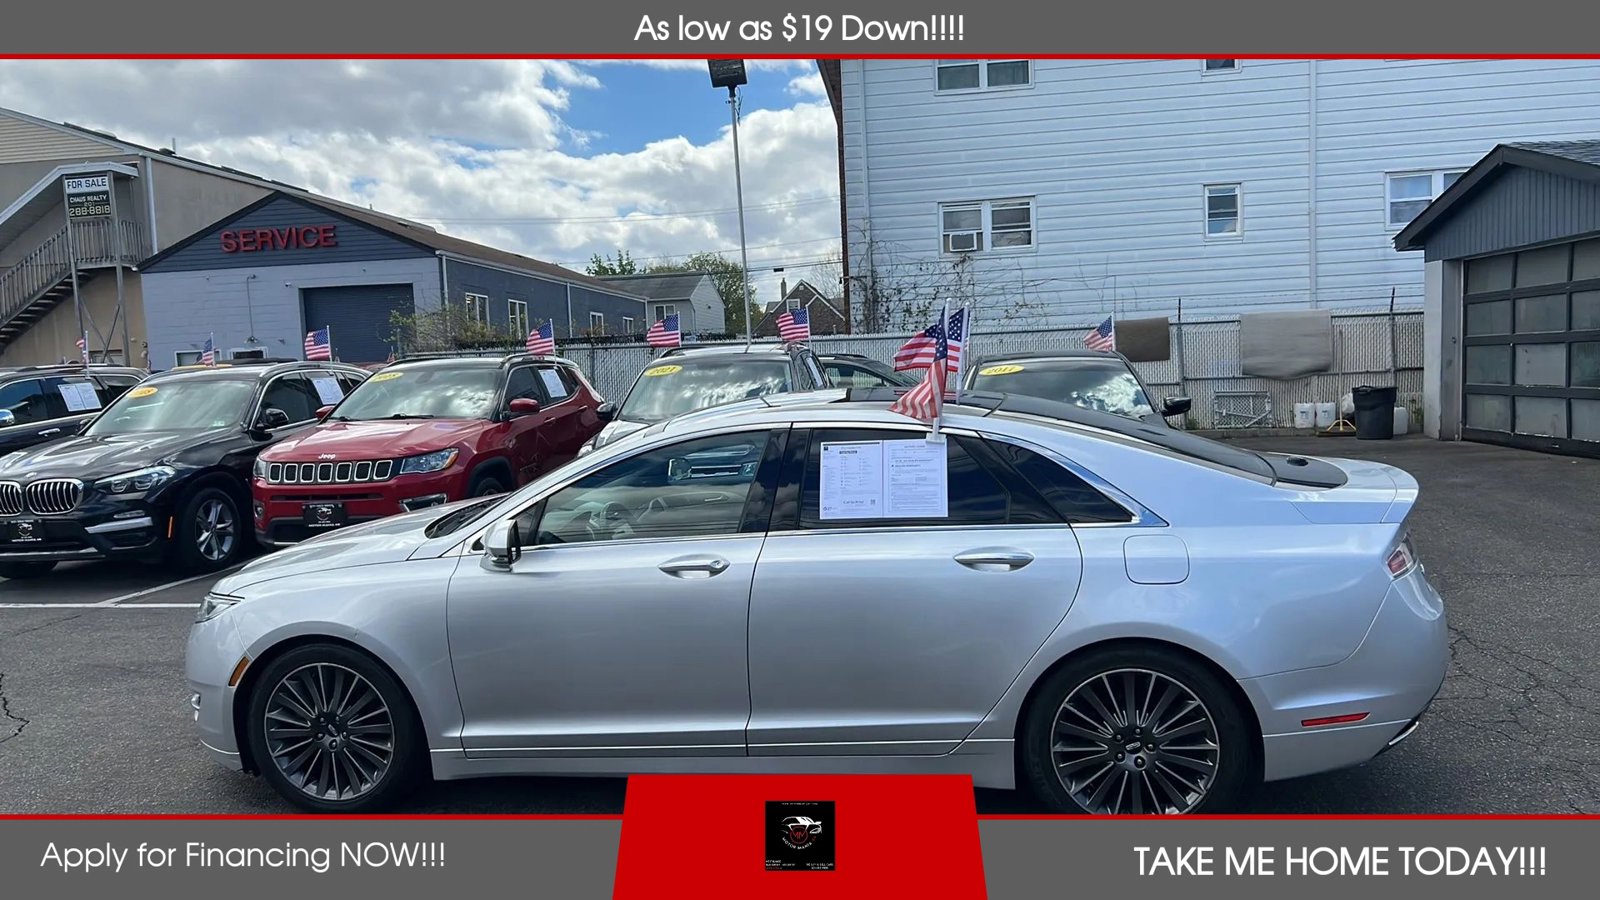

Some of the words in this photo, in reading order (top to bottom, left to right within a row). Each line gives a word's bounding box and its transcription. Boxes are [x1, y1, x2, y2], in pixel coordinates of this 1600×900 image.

[67, 180, 82, 189] FOR
[85, 178, 106, 188] SALE
[87, 194, 107, 202] REALTY
[69, 205, 110, 216] 288-8818
[220, 225, 337, 252] SERVICE
[318, 452, 336, 460] Jeep
